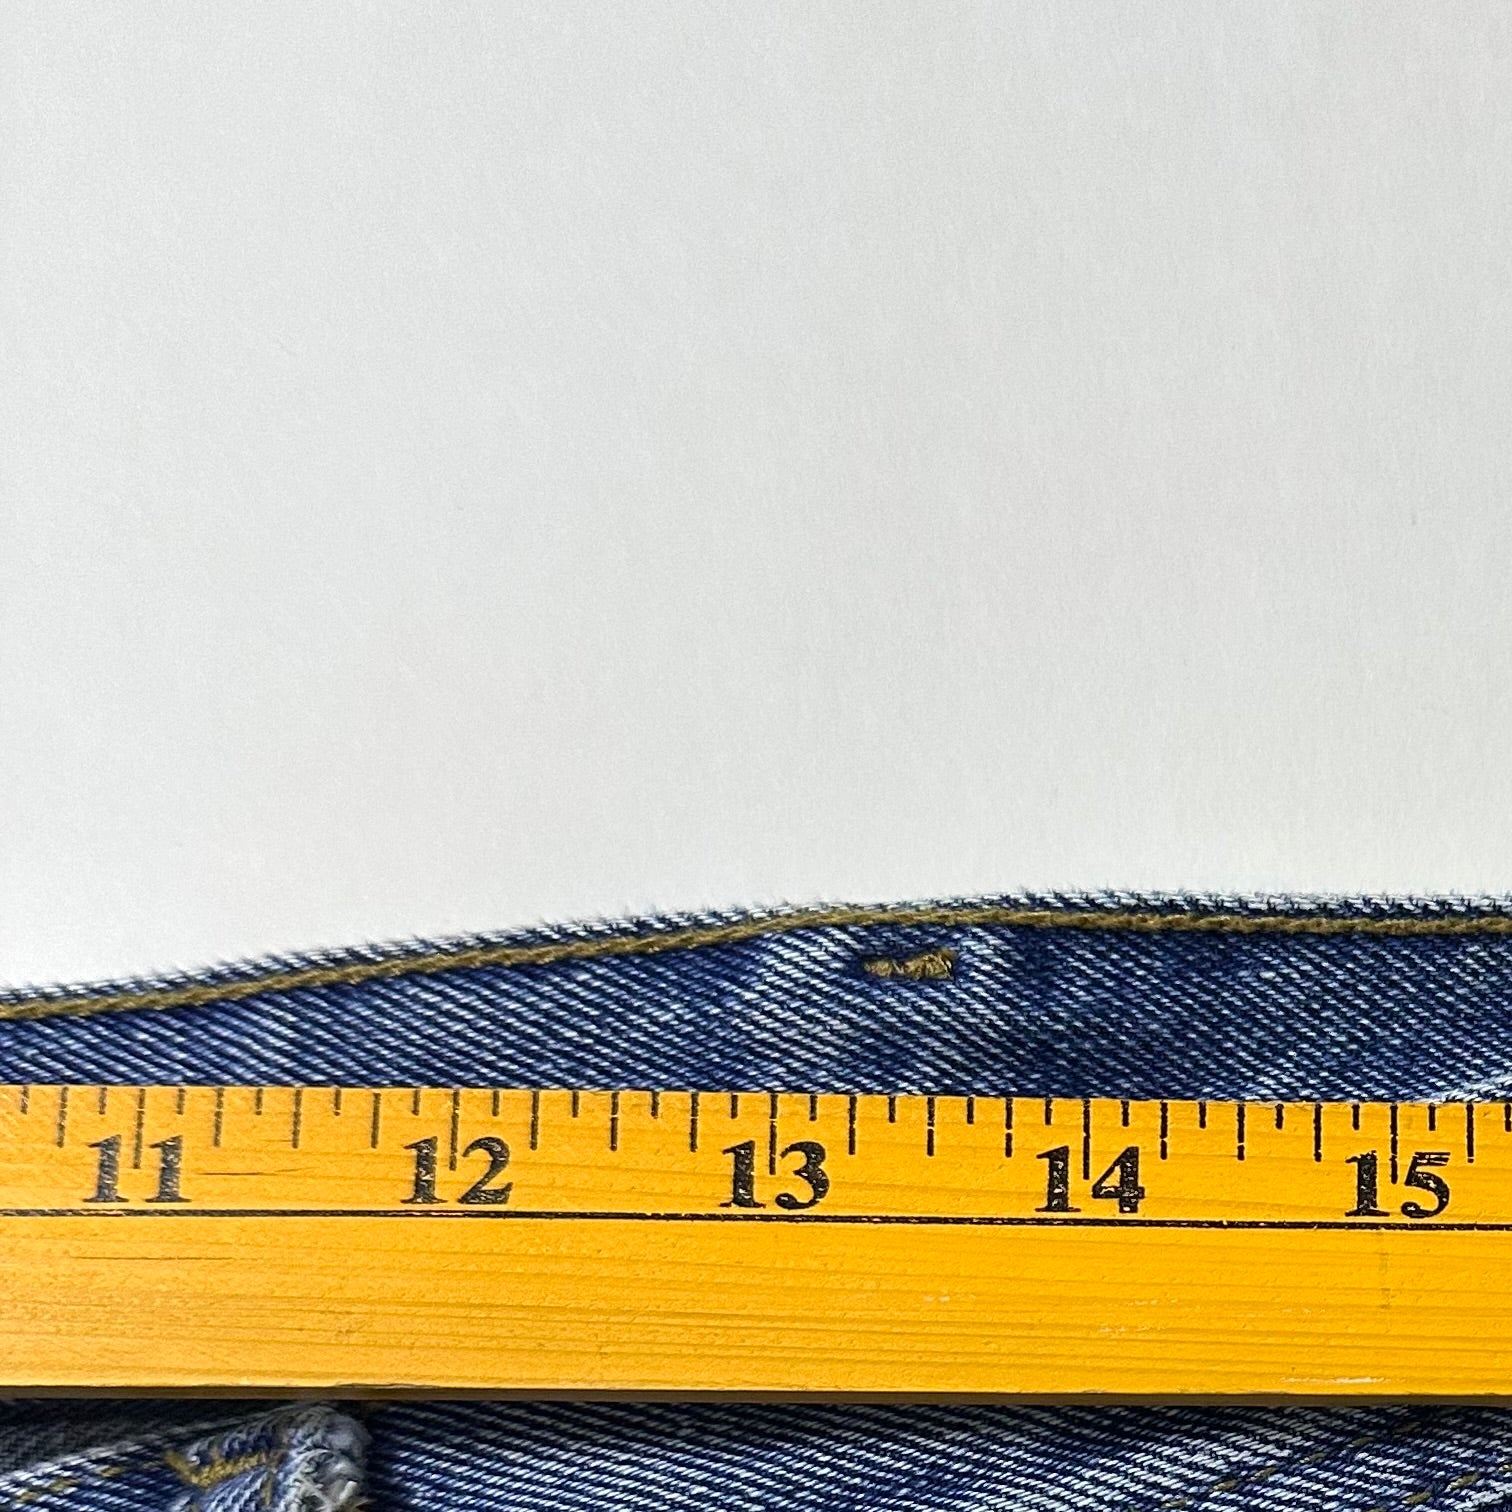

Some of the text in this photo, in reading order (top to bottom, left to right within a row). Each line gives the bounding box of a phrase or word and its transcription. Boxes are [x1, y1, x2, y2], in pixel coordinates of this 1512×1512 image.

[83, 1135, 190, 1204] 11
[401, 1136, 512, 1205] 12
[720, 1141, 829, 1210] 13
[1036, 1146, 1145, 1213] 14
[1345, 1150, 1450, 1218] 15
